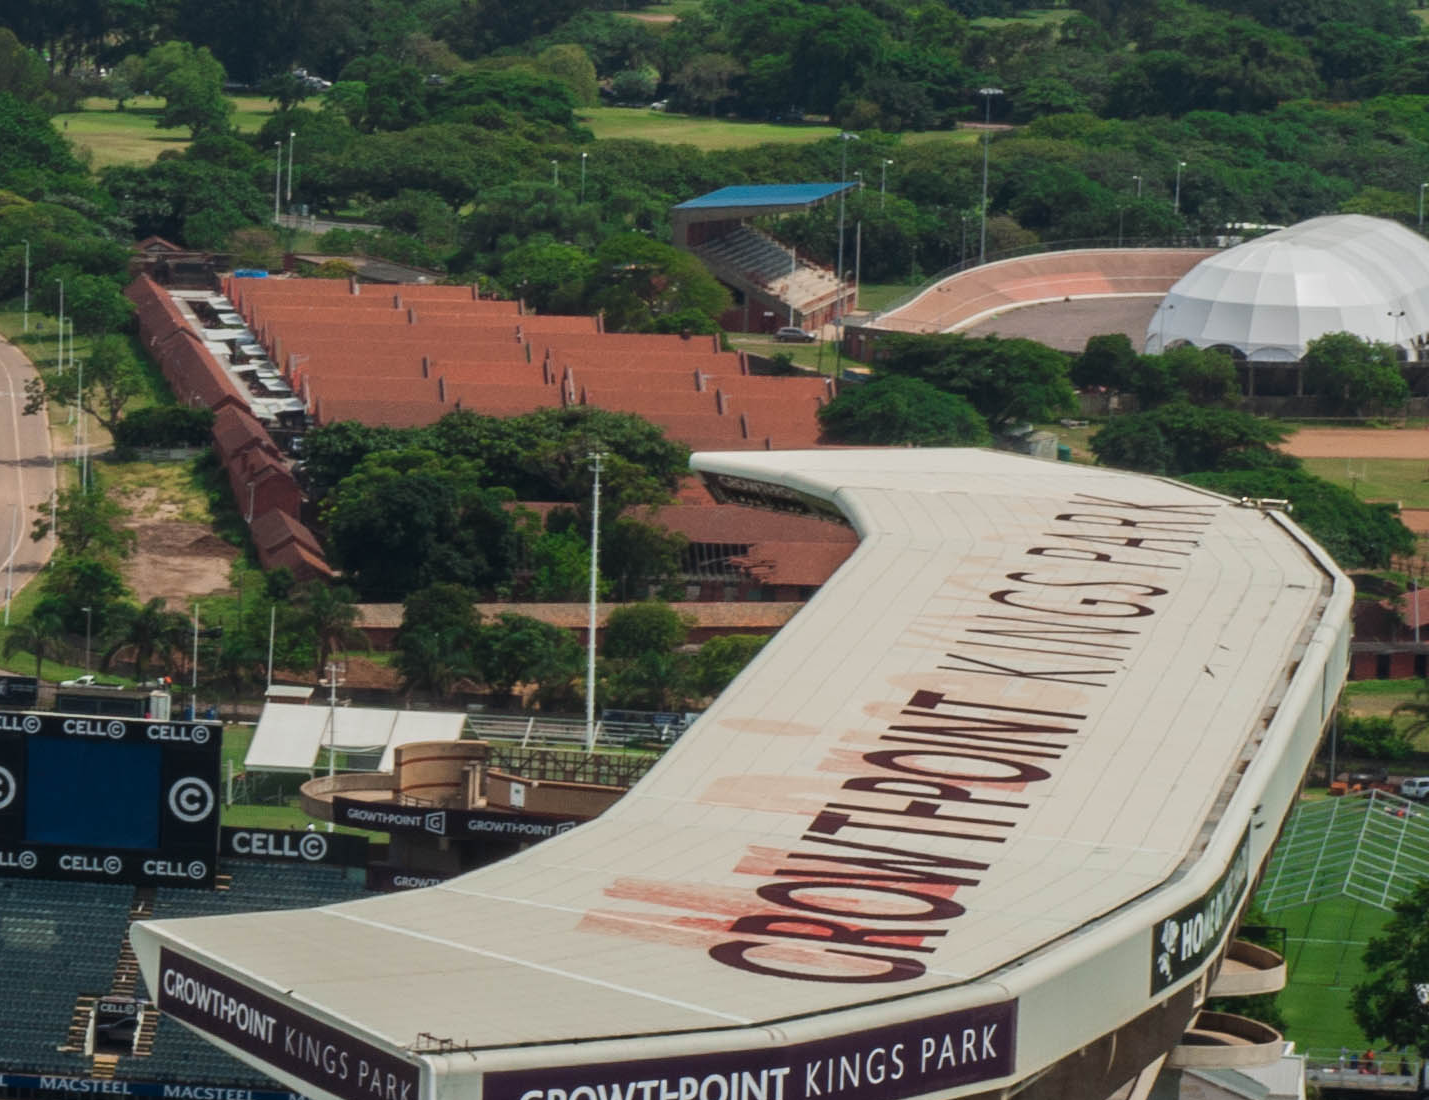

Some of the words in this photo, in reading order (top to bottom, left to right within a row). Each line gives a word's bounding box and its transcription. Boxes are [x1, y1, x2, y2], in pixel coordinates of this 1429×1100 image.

[1026, 494, 1221, 569] PARK
[937, 572, 1169, 687] KINGS
[40, 1077, 132, 1095] MACSTEEL
[285, 1026, 348, 1080] KINGS
[805, 1044, 904, 1098] KINGS
[921, 1024, 997, 1074] PARK
